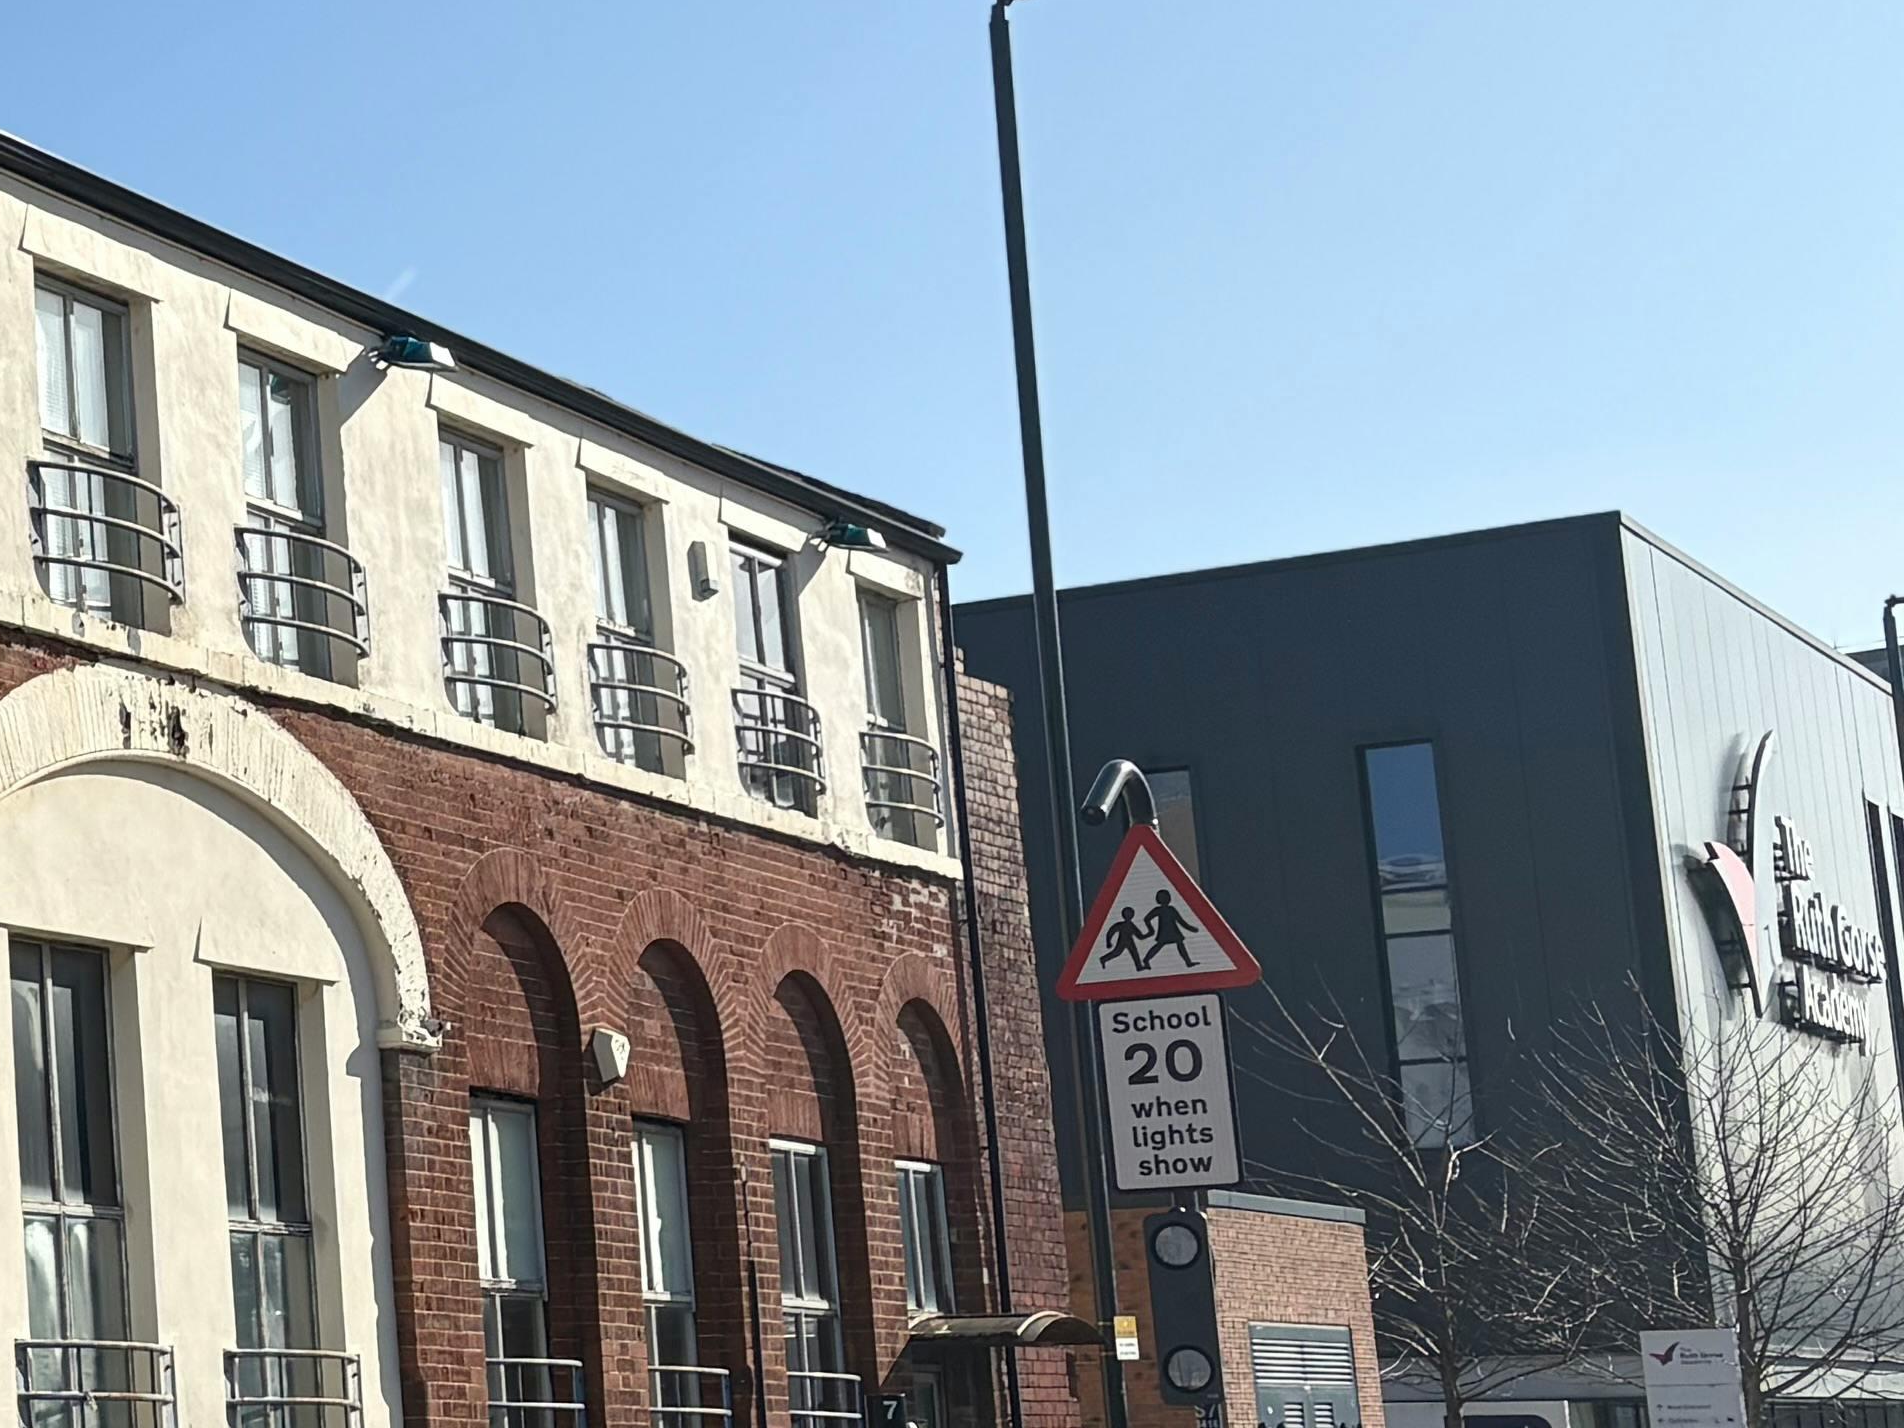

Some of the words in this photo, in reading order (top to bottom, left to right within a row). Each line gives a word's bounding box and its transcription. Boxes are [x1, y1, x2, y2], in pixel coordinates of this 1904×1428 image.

[1776, 816, 1814, 880] The
[1790, 883, 1837, 961] Ruth
[1834, 904, 1887, 979] Gorse
[1112, 1005, 1212, 1034] School
[1800, 963, 1872, 1057] Academy
[1124, 1039, 1203, 1086] 20
[1131, 1095, 1208, 1119] when
[1132, 1123, 1214, 1150] lights
[1138, 1154, 1213, 1176] show
[883, 1401, 898, 1419] 7
